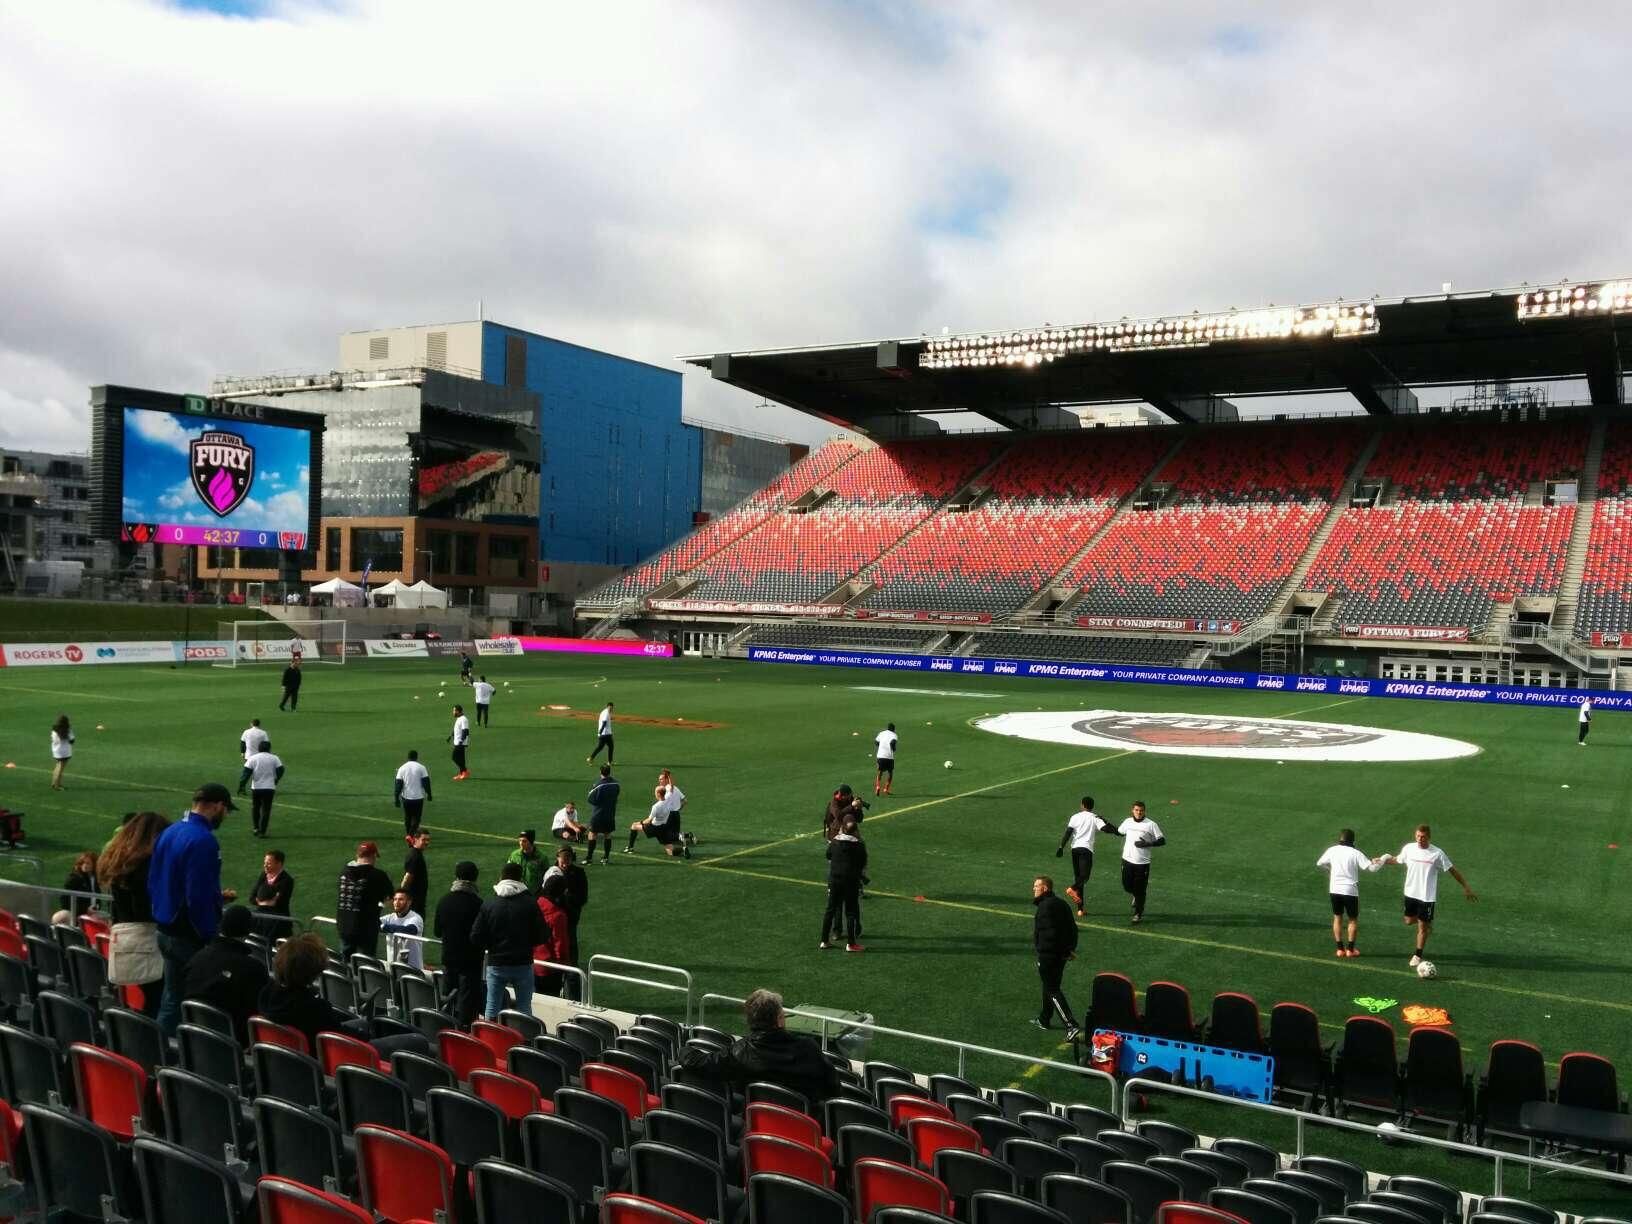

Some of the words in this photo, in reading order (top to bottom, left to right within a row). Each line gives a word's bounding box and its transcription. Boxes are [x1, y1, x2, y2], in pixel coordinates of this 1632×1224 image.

[211, 400, 265, 419] PLACE
[205, 435, 241, 446] OTTAWA
[195, 445, 250, 470] FURY
[175, 528, 183, 541] 0
[203, 529, 240, 544] 42:37
[258, 533, 267, 545] 0
[1088, 617, 1114, 627] STAY
[1116, 618, 1186, 629] CONNECTED!
[1363, 627, 1410, 637] OTTAWA
[1413, 628, 1446, 638] FURY
[185, 647, 228, 658] PODS
[644, 643, 667, 654] 42:37
[14, 650, 63, 661] ROGERS
[66, 649, 79, 659] TV
[754, 650, 778, 660] KPMG
[778, 651, 814, 662] Enterprise
[819, 655, 836, 663] YOUR
[836, 656, 862, 664] PRIVATE
[862, 657, 894, 666] COMPANY
[894, 659, 922, 667] ADVISER
[930, 661, 953, 670] KPMG
[962, 663, 984, 672] KPMG
[993, 665, 1017, 674] KPMG
[1028, 664, 1059, 675] KPMG
[1059, 666, 1105, 678] Enterprise
[1112, 670, 1134, 679] YOUR
[1135, 672, 1167, 680] PRIVATE
[1167, 673, 1208, 683] COMPANY
[1208, 675, 1245, 685] ADVISER
[1256, 678, 1284, 689] KPMG
[1296, 680, 1327, 691] KPMG
[1339, 683, 1370, 694] KPMG
[1385, 683, 1425, 695] KPMG
[1425, 685, 1487, 699] Enterprise
[1496, 691, 1524, 701] YOUR
[1525, 692, 1568, 703] PRIVATE
